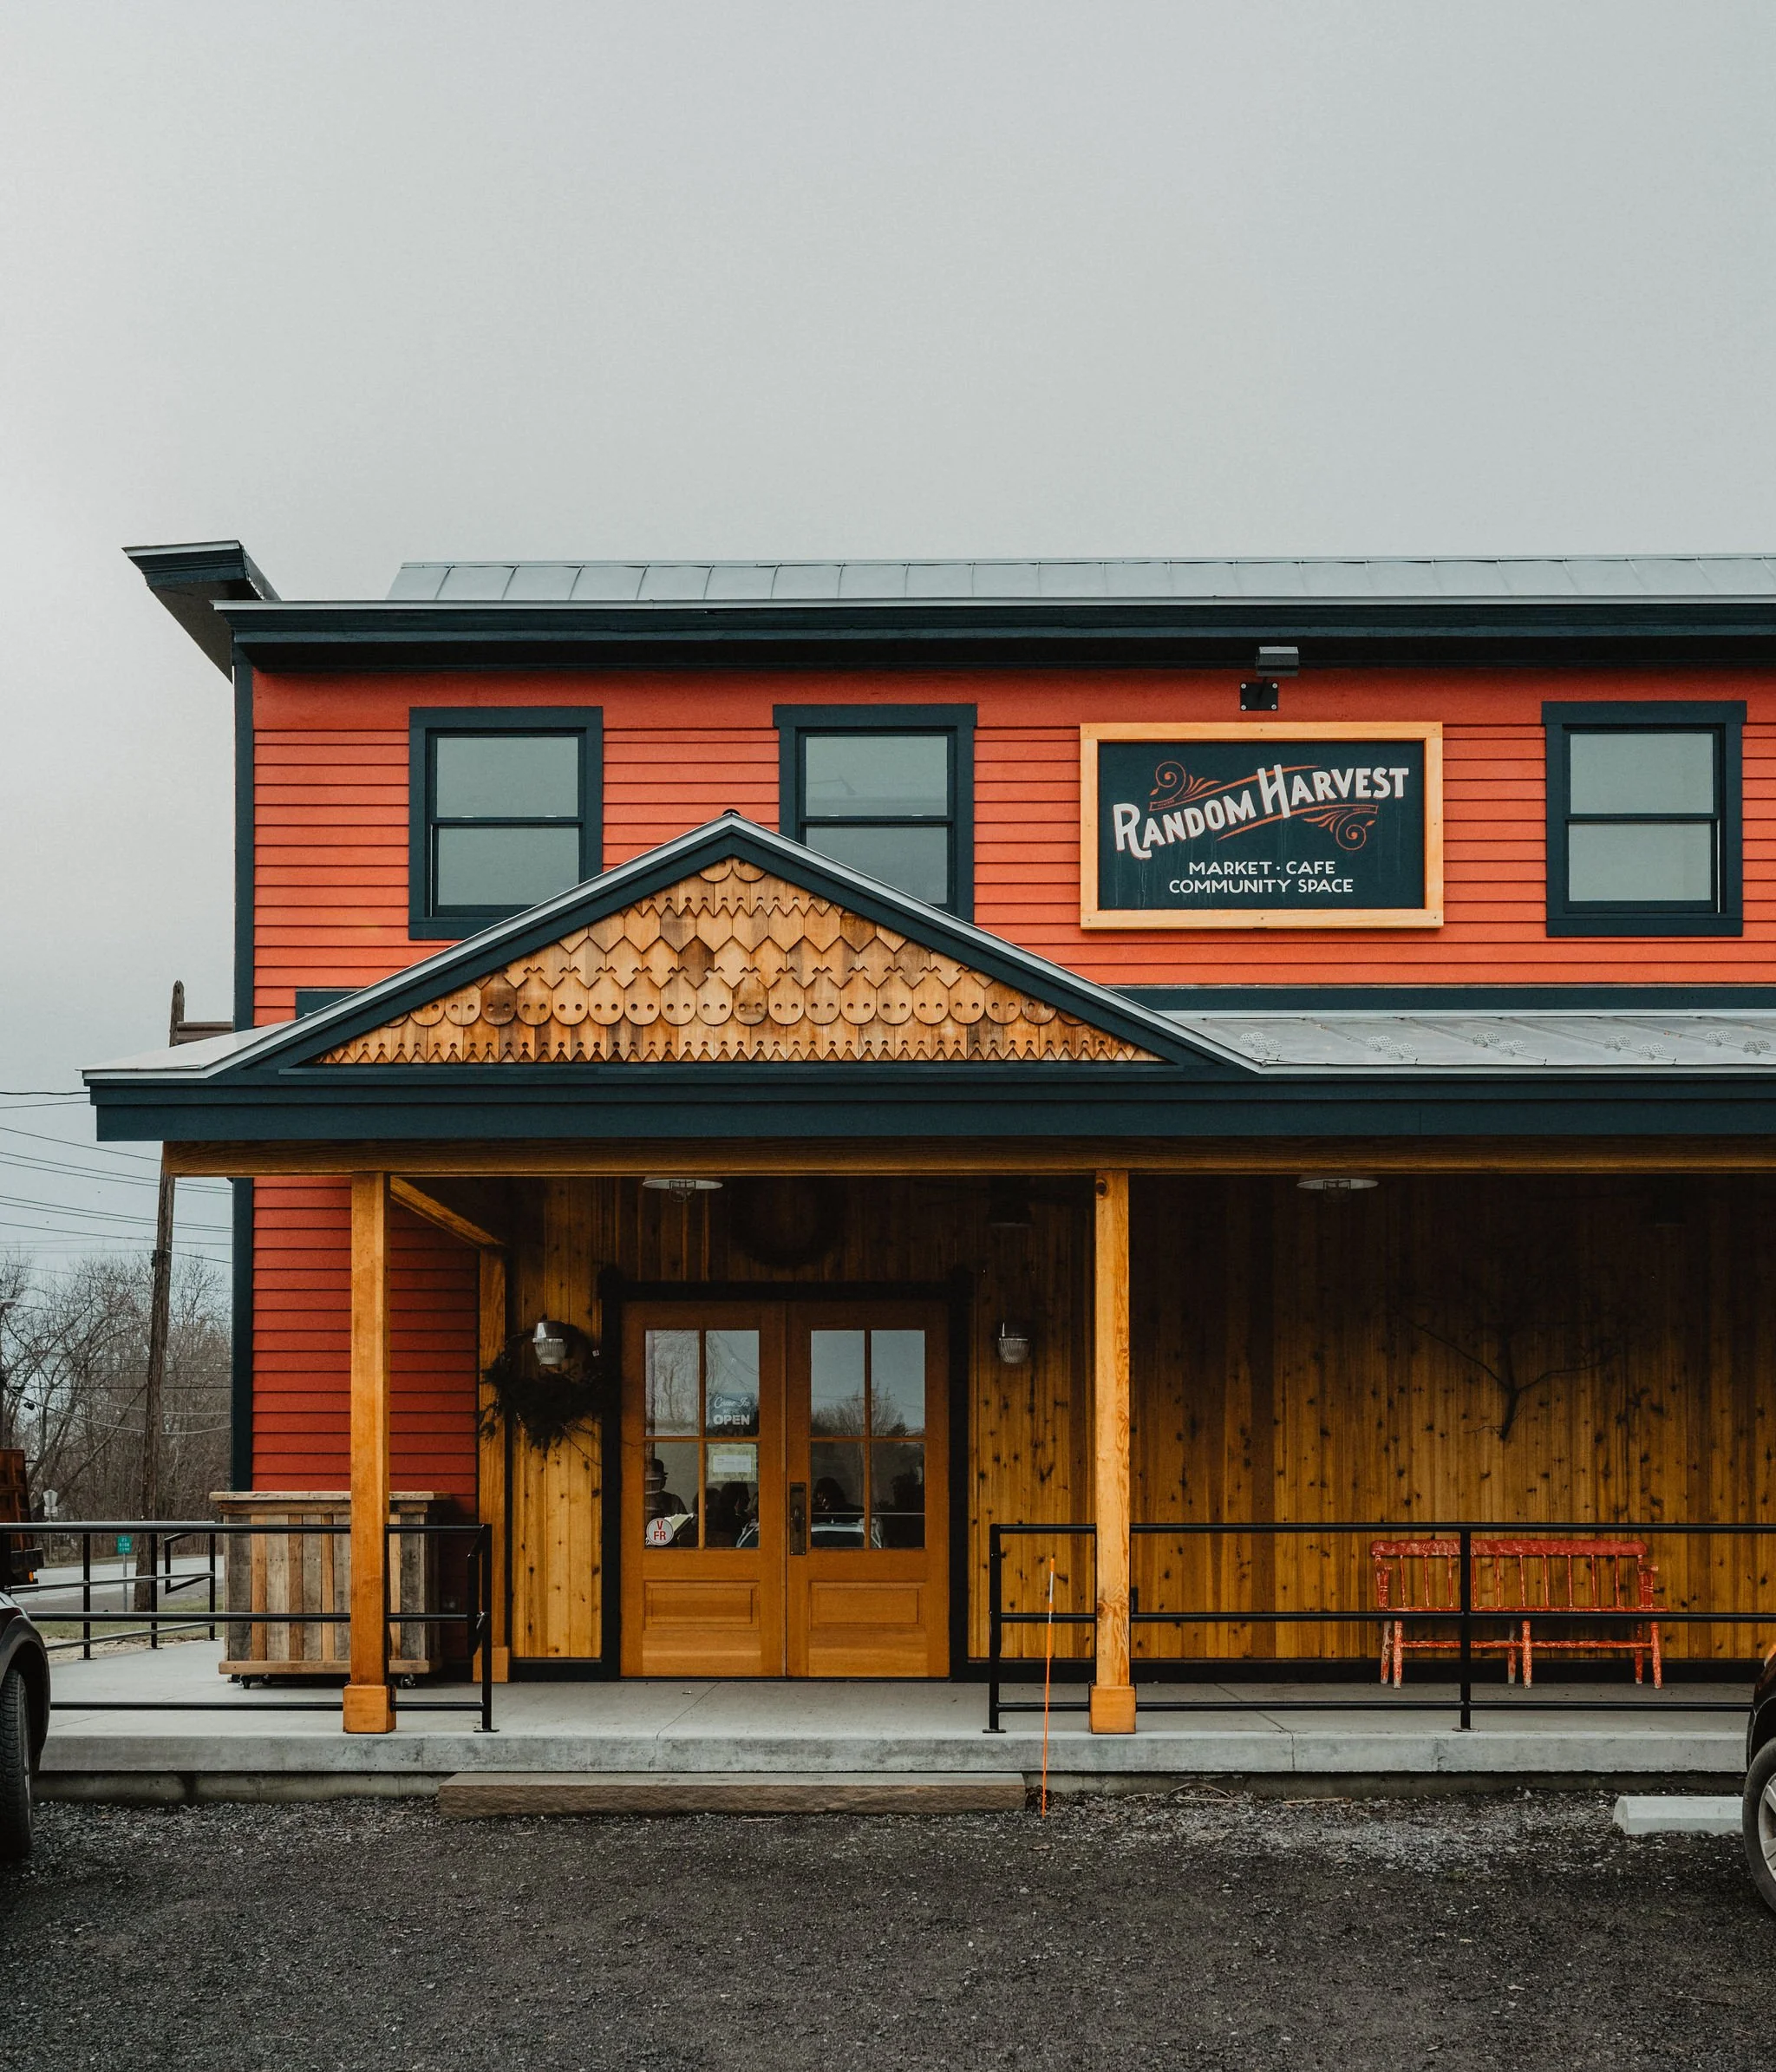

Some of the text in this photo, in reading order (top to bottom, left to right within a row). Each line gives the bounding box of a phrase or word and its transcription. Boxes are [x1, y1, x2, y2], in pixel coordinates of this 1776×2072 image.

[1113, 763, 1409, 859] RANDOM HARVEST
[1189, 860, 1335, 875] MARKET CAFE
[1169, 879, 1354, 893] COMMUNITY SPACE
[714, 1396, 735, 1409] Come
[713, 1414, 750, 1426] OPEN
[656, 1520, 664, 1530] V
[653, 1531, 667, 1540] FR
